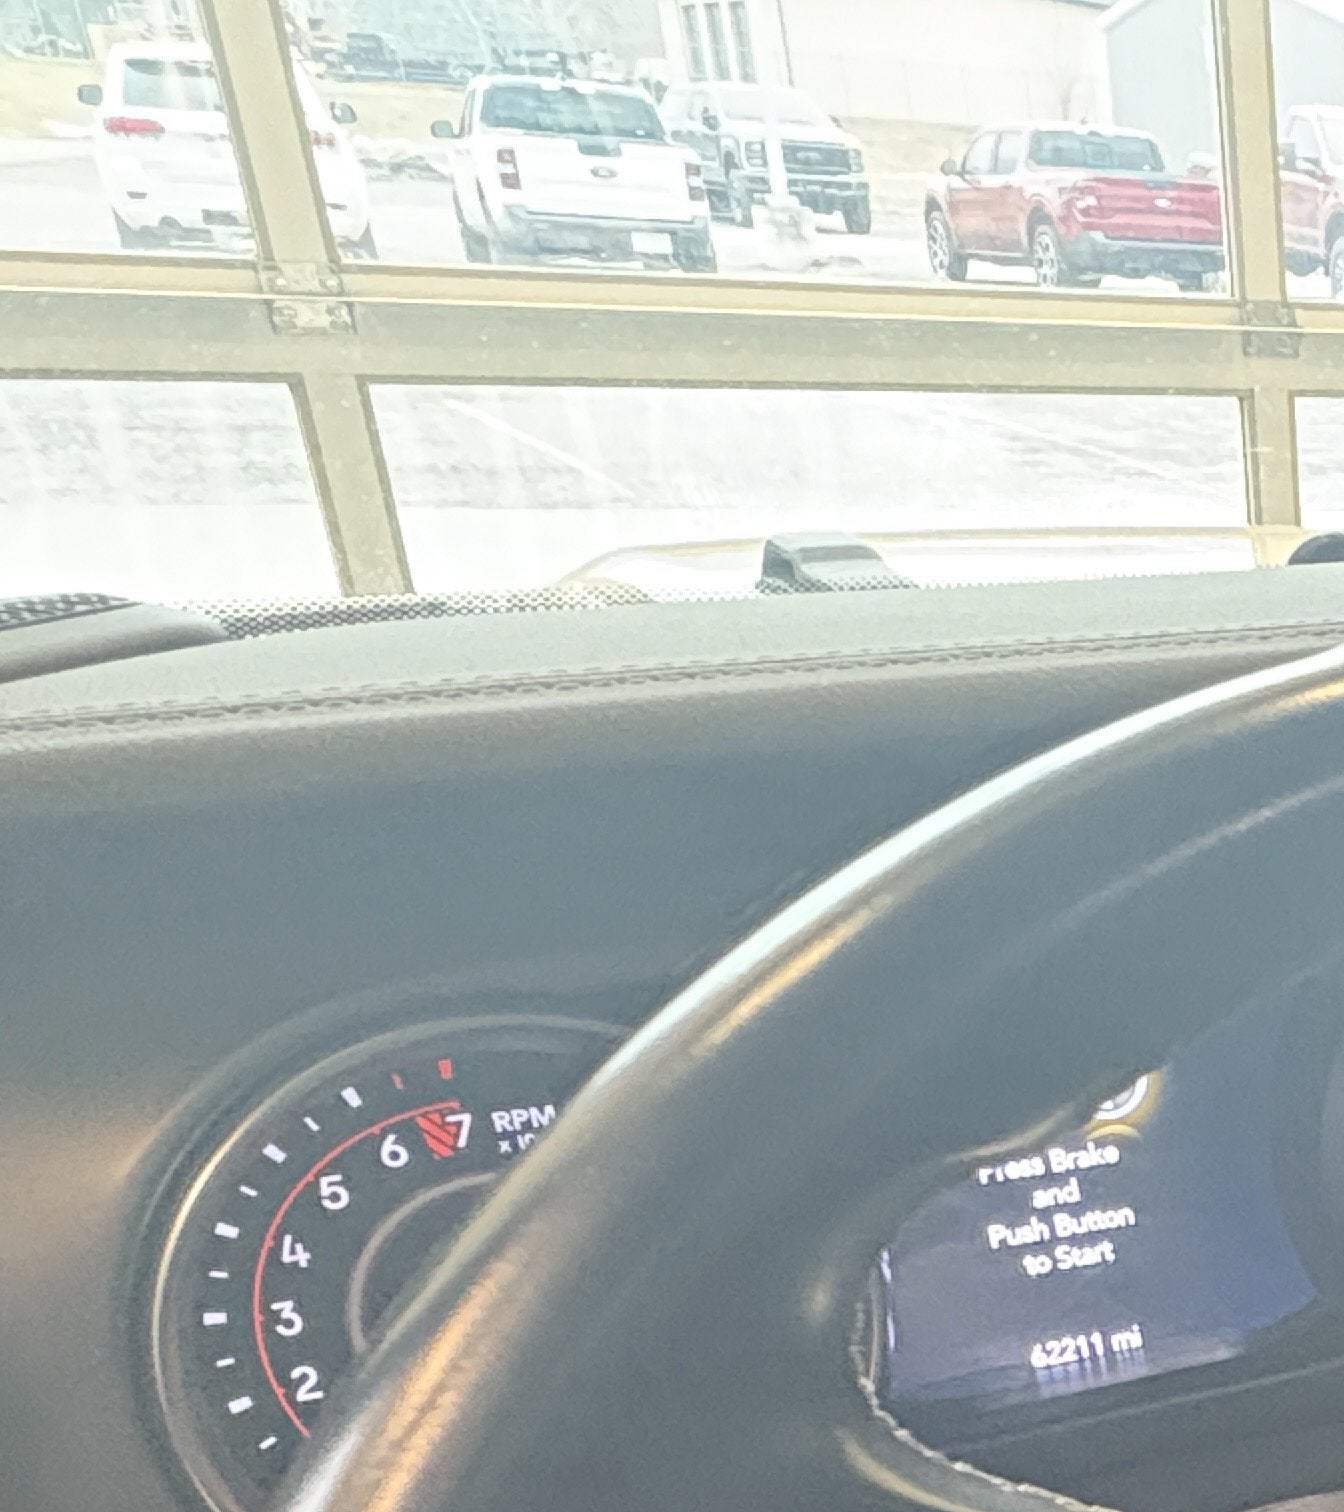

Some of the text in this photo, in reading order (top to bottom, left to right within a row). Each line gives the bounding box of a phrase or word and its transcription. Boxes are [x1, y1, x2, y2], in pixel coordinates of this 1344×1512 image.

[446, 1112, 473, 1149] 7
[491, 1104, 556, 1135] RPM
[380, 1134, 410, 1169] 6
[1048, 1141, 1121, 1174] Brake
[319, 1175, 350, 1210] 5
[1032, 1177, 1082, 1209] and
[987, 1206, 1136, 1250] Push Button
[282, 1234, 311, 1269] 4
[1022, 1240, 1116, 1276] to Start
[271, 1301, 304, 1338] 3
[1030, 1323, 1144, 1369] 62211 mi
[290, 1365, 324, 1402] 2
